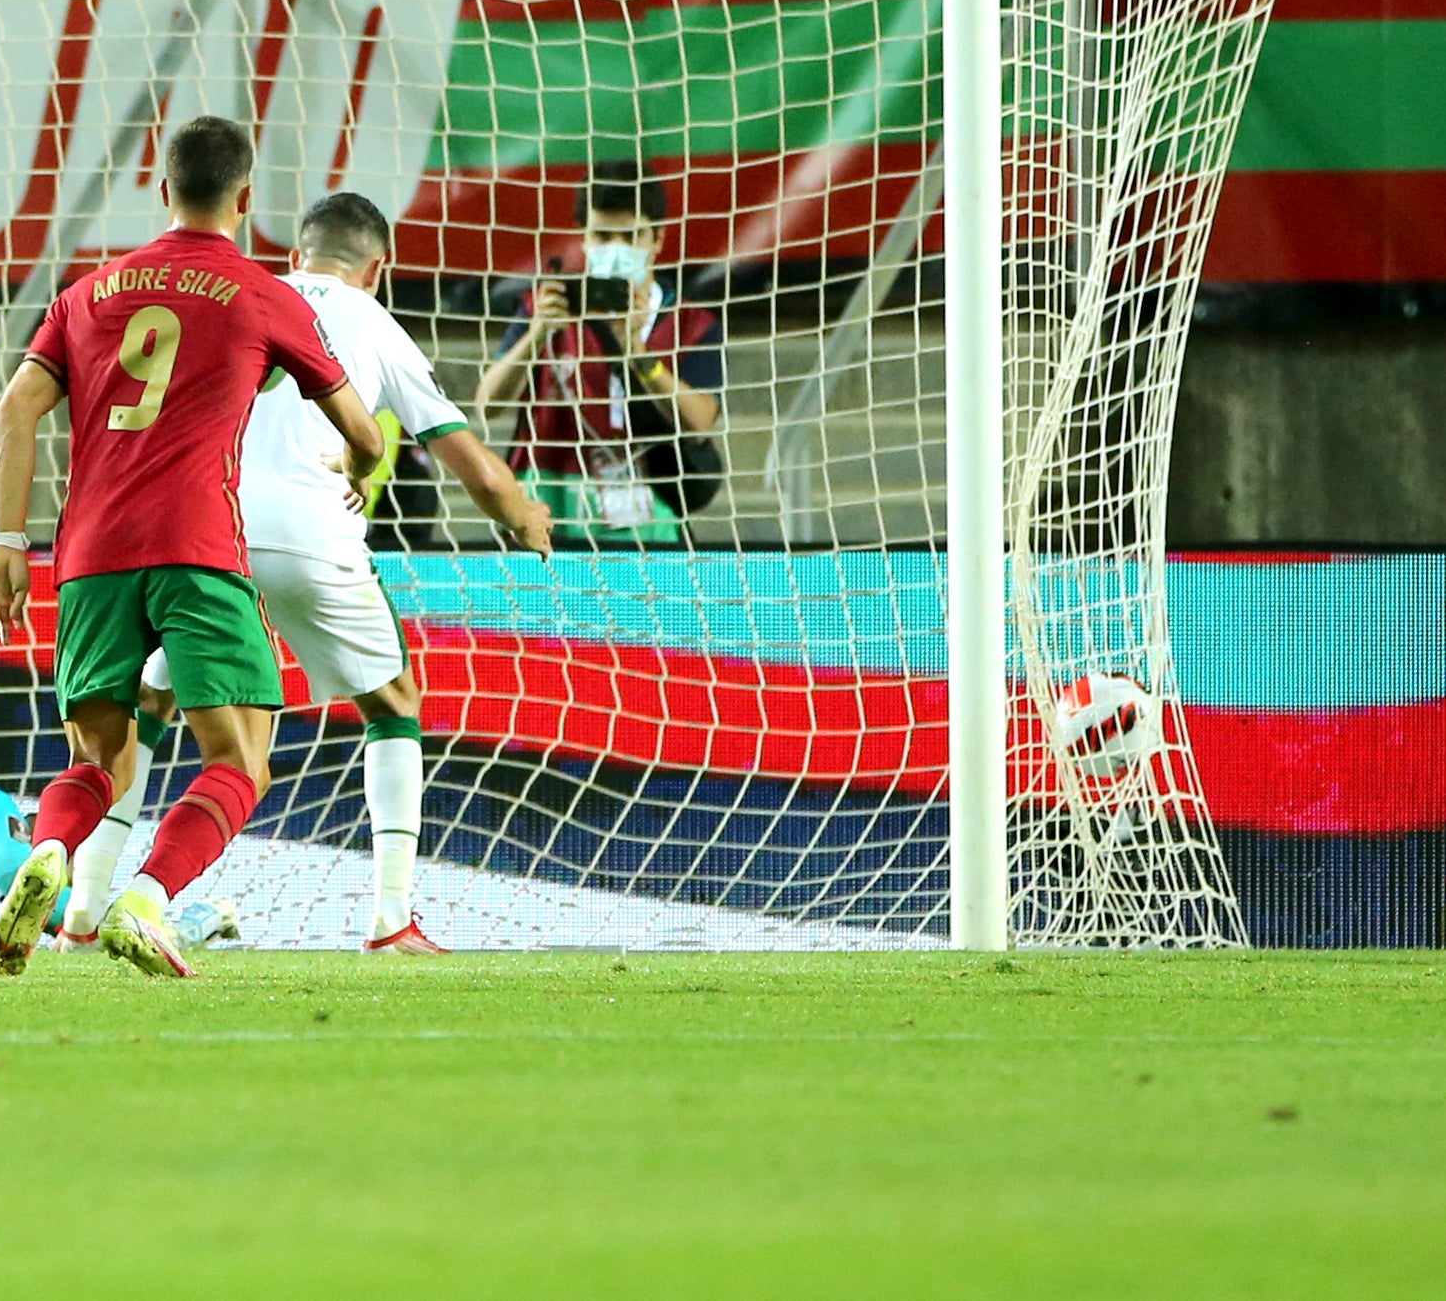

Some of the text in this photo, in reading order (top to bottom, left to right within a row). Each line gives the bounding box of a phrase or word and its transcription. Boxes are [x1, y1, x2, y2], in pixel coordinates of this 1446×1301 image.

[93, 262, 242, 307] ANDRÉ SILVA
[107, 305, 182, 432] 9
